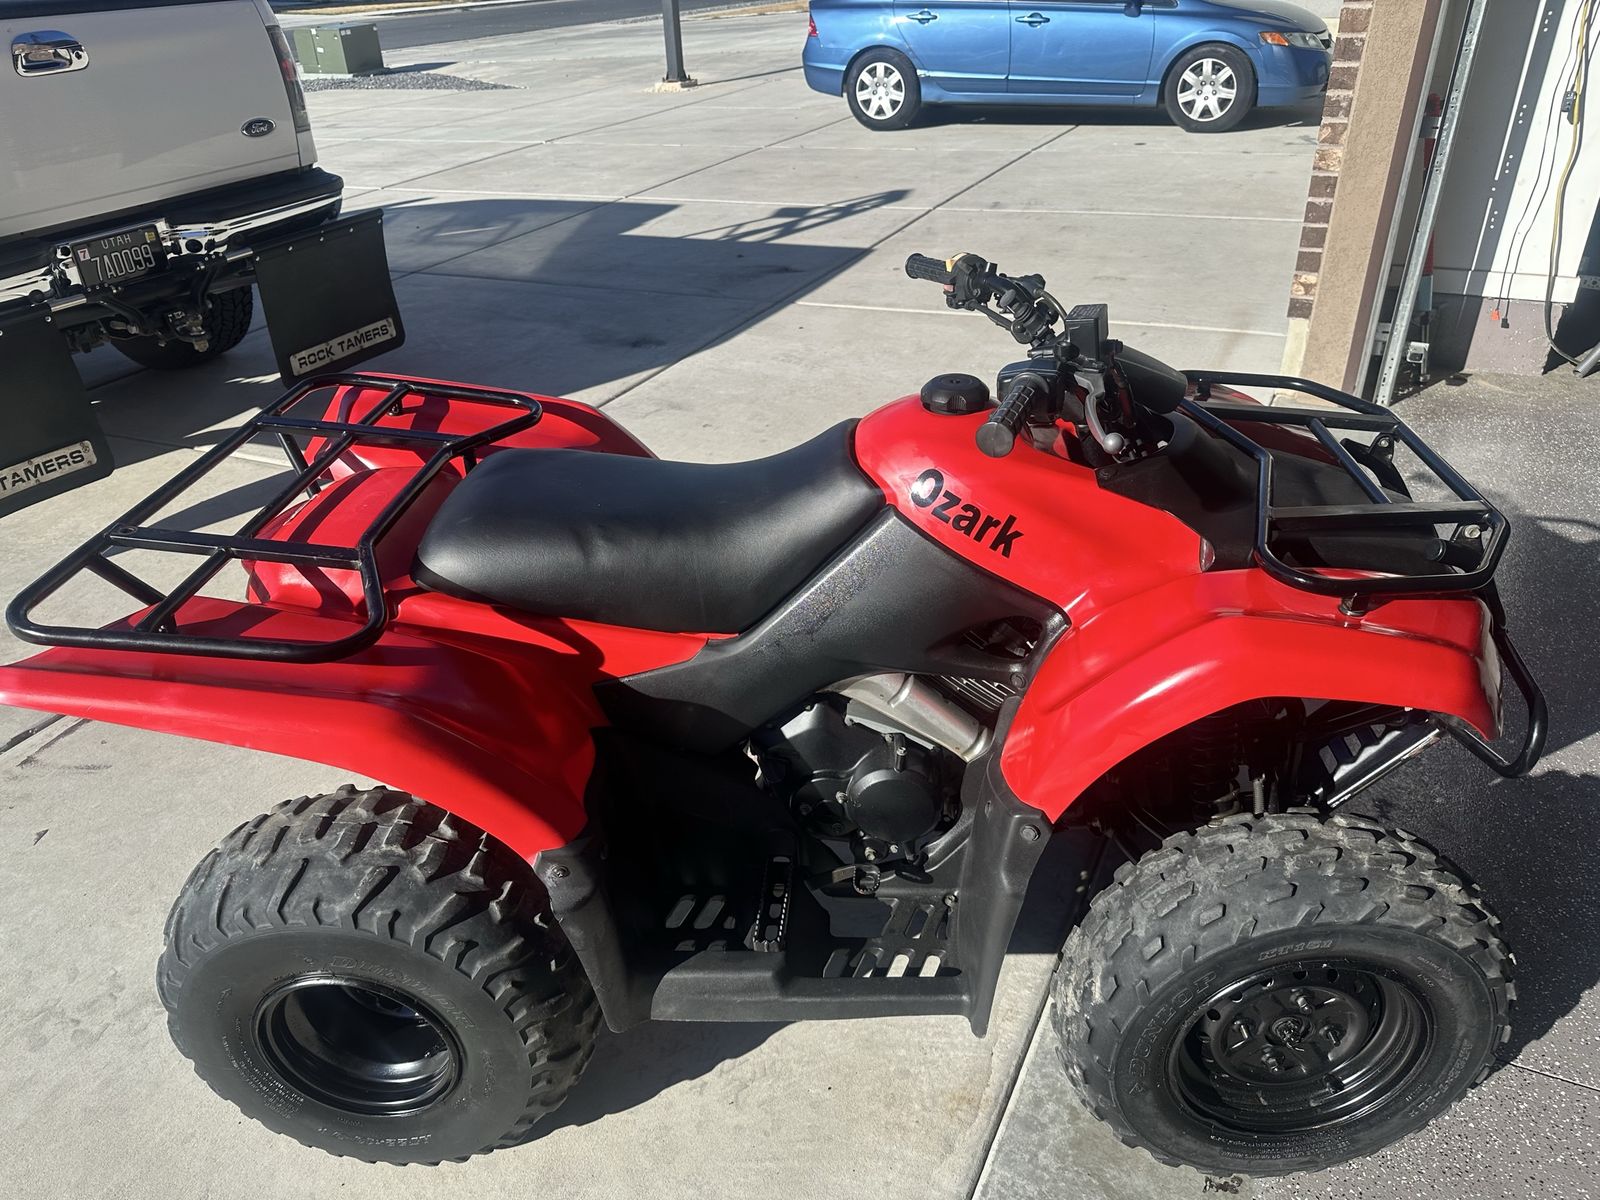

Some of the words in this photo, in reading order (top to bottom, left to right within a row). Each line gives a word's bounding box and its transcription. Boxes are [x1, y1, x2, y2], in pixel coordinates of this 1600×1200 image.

[251, 122, 268, 134] Ford
[79, 250, 87, 259] 7
[101, 234, 131, 250] UTAH
[91, 244, 156, 281] 7AD099
[298, 345, 335, 368] ROCK
[338, 324, 389, 352] TAMERS
[0, 449, 85, 490] TAMERS
[911, 468, 1024, 559] Ozark
[1128, 970, 1217, 1077] DUNLOP
